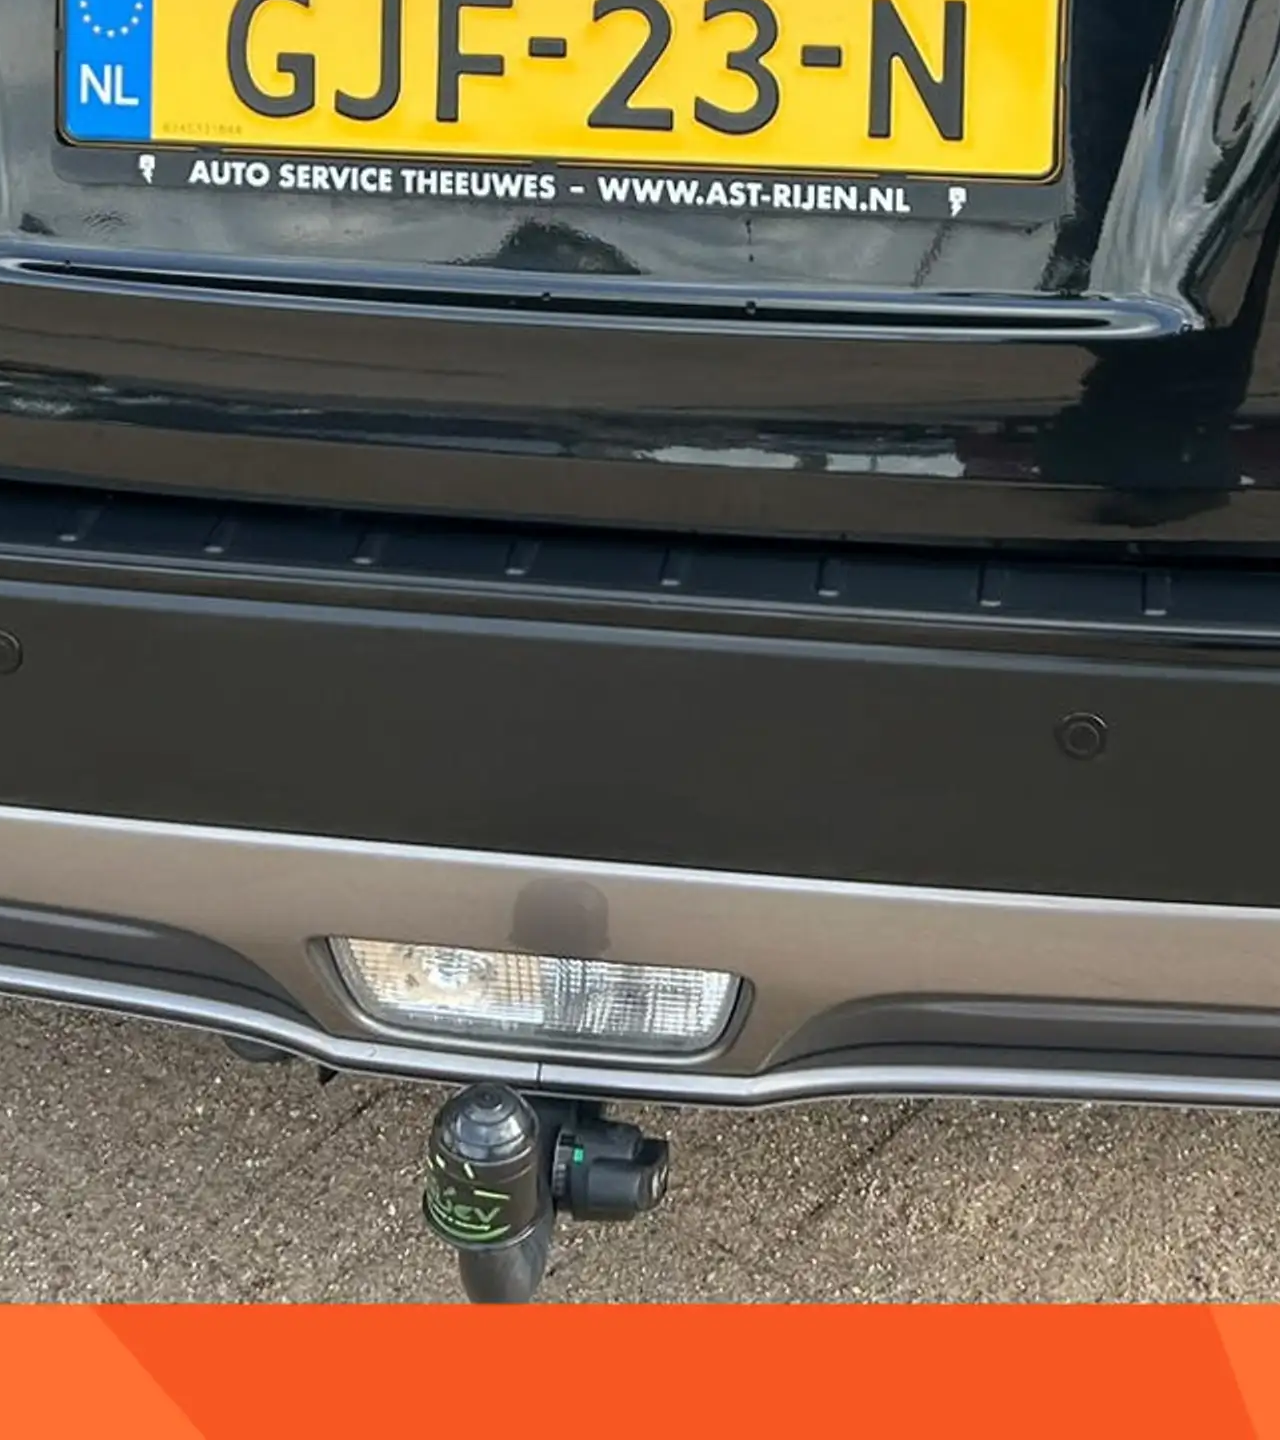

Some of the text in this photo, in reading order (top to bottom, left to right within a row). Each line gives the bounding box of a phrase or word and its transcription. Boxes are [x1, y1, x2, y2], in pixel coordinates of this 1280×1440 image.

[78, 63, 139, 108] NL
[188, 159, 271, 188] AUTO
[278, 163, 393, 193] SERVICE
[401, 170, 557, 200] THEEUWES
[597, 175, 911, 214] WWW.AST-RIJEN.NL
